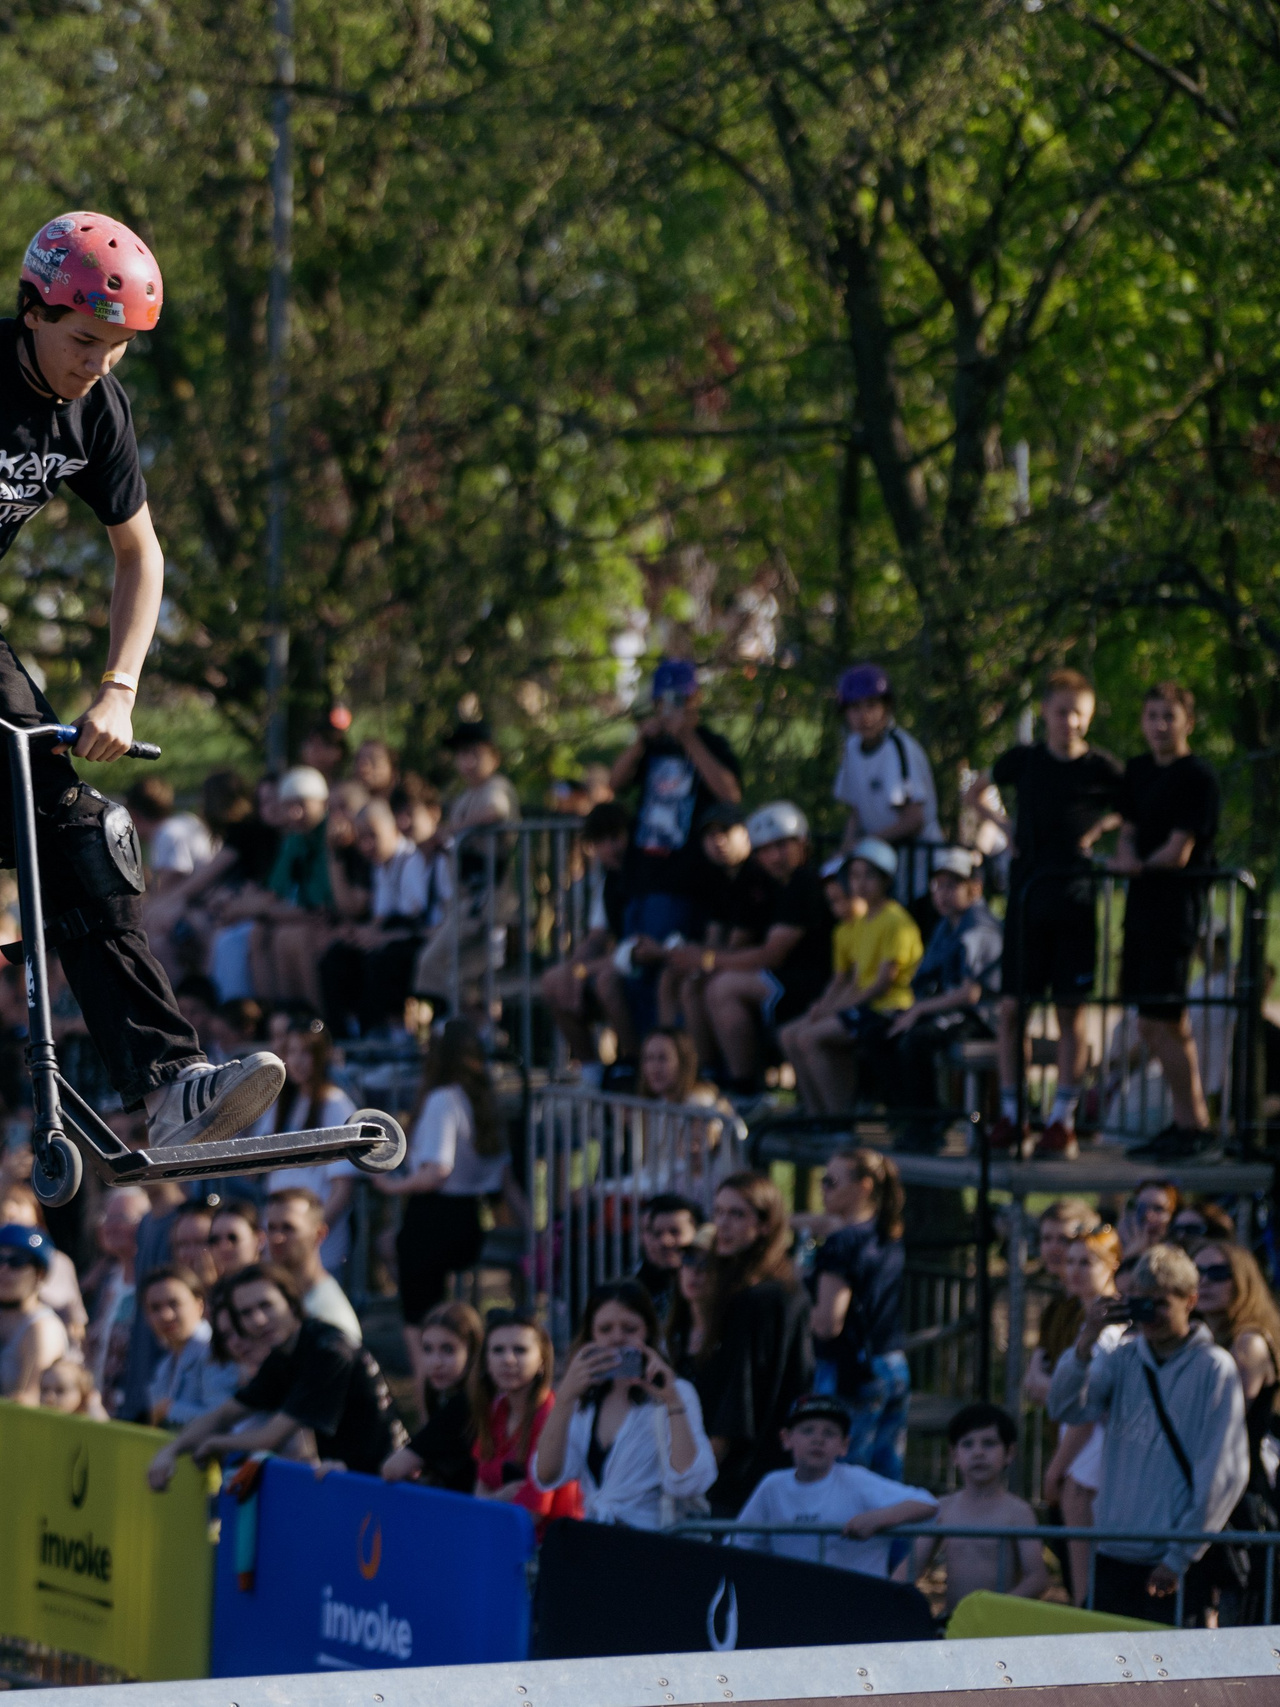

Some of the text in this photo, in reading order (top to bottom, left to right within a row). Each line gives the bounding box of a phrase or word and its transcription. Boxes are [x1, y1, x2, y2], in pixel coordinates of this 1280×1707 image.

[94, 307, 121, 317] EXTREME
[41, 1516, 112, 1583] invoke
[322, 1584, 412, 1660] invoke
